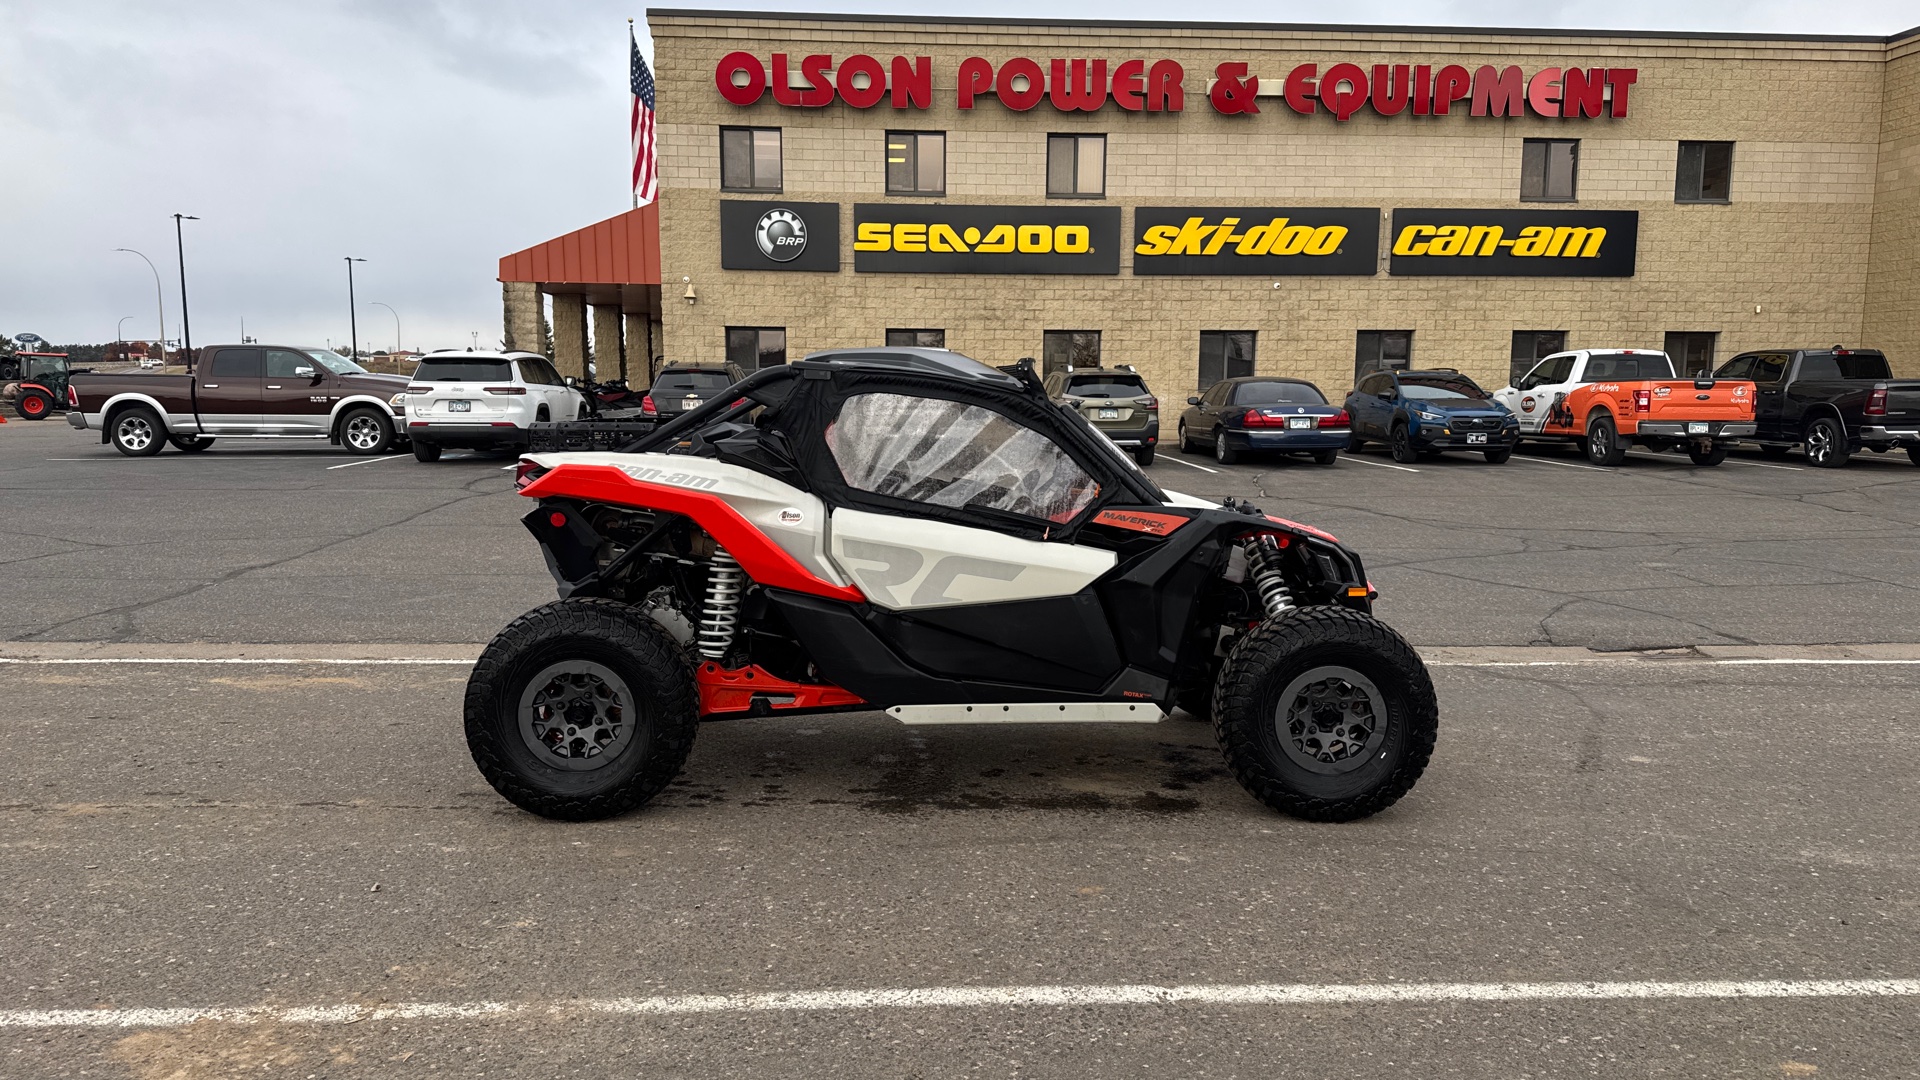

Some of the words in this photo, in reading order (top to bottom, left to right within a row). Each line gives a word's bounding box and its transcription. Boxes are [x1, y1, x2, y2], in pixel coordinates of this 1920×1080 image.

[715, 51, 933, 110] OLSON
[957, 56, 1185, 112] POWER
[1209, 62, 1261, 115] &
[1283, 63, 1638, 122] EQUIPMENT
[776, 236, 805, 246] BRP
[1135, 217, 1349, 256] ski-doo
[1392, 224, 1607, 258] can-am
[1103, 511, 1167, 529] MAVERICK
[1123, 690, 1144, 698] ROTAX
